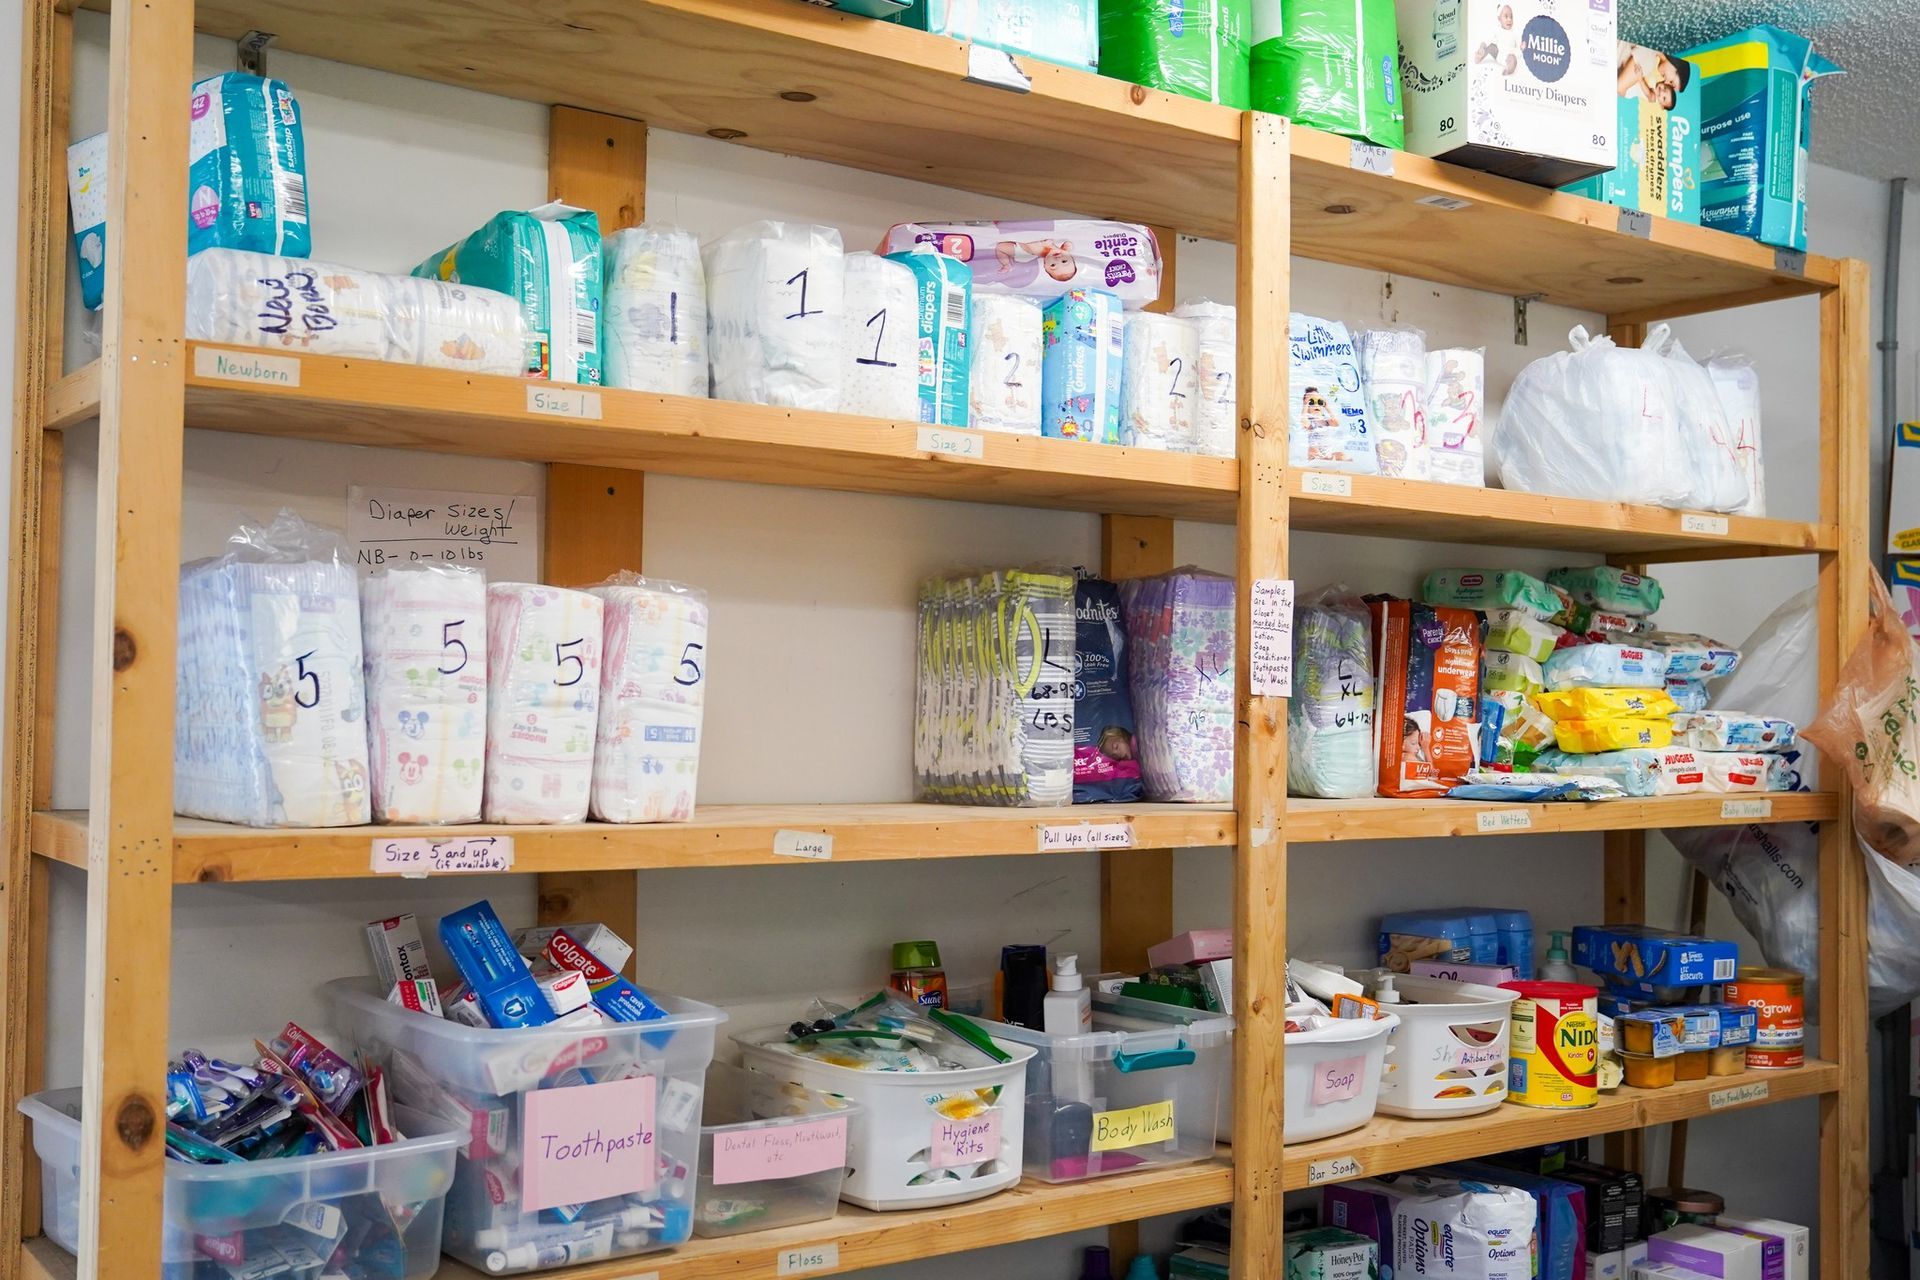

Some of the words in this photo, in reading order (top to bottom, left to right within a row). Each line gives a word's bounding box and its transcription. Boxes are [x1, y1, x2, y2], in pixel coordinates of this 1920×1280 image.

[1527, 33, 1565, 57] Millie
[1533, 52, 1561, 66] MOON
[1504, 79, 1544, 100] Luxury
[1545, 87, 1588, 107] Diapers
[192, 96, 205, 111] 42
[1439, 117, 1454, 132] 80
[1701, 119, 1733, 136] urpose
[1735, 112, 1751, 123] use
[285, 127, 296, 168] diapers
[1592, 134, 1606, 146] 80
[1353, 143, 1387, 157] WOMEN
[1656, 116, 1665, 200] swaddlers
[1363, 157, 1376, 170] M
[1670, 115, 1690, 213] Pampers
[1629, 220, 1637, 232] L
[1095, 236, 1138, 250] Gentle
[1112, 247, 1137, 257] Dry
[785, 267, 824, 320] 1
[920, 280, 937, 334] diapers
[856, 308, 898, 367] 1
[1306, 323, 1334, 345] Little
[1291, 342, 1352, 361] Swimmers
[216, 355, 289, 382] Newborn
[1003, 352, 1023, 387] 2
[1168, 357, 1186, 398] 2
[534, 393, 570, 412] Size
[1341, 407, 1364, 416] NEMO
[1358, 418, 1367, 434] 3
[1442, 390, 1476, 449] 3
[931, 432, 957, 451] Size
[963, 442, 973, 454] 2
[1737, 418, 1757, 496] 4
[1311, 477, 1333, 491] Size
[1338, 479, 1346, 493] 3
[368, 499, 436, 522] Diaper
[444, 522, 513, 544] Weight
[1687, 517, 1705, 531] Size
[1711, 519, 1718, 529] 4
[1254, 581, 1286, 598] Samples
[1075, 597, 1120, 621] odnites
[1253, 598, 1265, 606] are
[1281, 597, 1292, 607] the
[1279, 608, 1285, 617] in
[1599, 614, 1627, 628] HUGGIES
[1253, 619, 1276, 628] marked
[1278, 619, 1290, 629] bins
[1254, 631, 1275, 641] Lotion
[437, 619, 468, 675] 5
[1043, 627, 1071, 673] L
[1253, 651, 1291, 661] Conditioner
[1254, 642, 1269, 653] Soap
[1620, 649, 1644, 660] HUGGIES
[553, 638, 584, 686] 5
[673, 643, 703, 686] 5
[1084, 654, 1109, 663] 100%
[1253, 661, 1289, 675] Toothpaste
[295, 649, 320, 709] 5
[1252, 671, 1267, 687] Body
[1270, 675, 1288, 686] Wash
[1338, 659, 1352, 680] L
[1437, 666, 1476, 678] underwear
[1341, 681, 1363, 701] XL
[1032, 708, 1072, 733] LBS
[1665, 753, 1695, 765] HUGGIES
[1043, 829, 1060, 844] Pull
[1065, 831, 1082, 845] Ups
[1086, 828, 1102, 844] (all
[1104, 829, 1130, 844] sizes)
[384, 843, 421, 863] Size
[430, 845, 441, 859] 5
[445, 847, 467, 859] and
[473, 849, 489, 862] up
[795, 840, 823, 857] Large
[1746, 823, 1805, 890] rshalls.com
[456, 857, 508, 870] available)
[396, 944, 414, 981] ontax
[552, 935, 597, 976] Colgate
[919, 992, 942, 1006] Suave
[1763, 1005, 1793, 1018] grow
[1325, 1070, 1355, 1091] Soap
[1098, 1115, 1138, 1142] Body
[1142, 1103, 1173, 1134] Wash
[540, 1122, 653, 1163] Toothpaste
[942, 1121, 990, 1145] Hygiene
[725, 1137, 756, 1152] Dental
[1310, 1165, 1325, 1181] Bar
[1332, 1160, 1356, 1178] Soap
[1487, 1228, 1512, 1237] equate
[1413, 1217, 1429, 1275] Options
[1443, 1223, 1455, 1272] equate
[1488, 1248, 1517, 1260] Options
[788, 1252, 823, 1268] Floss
[1331, 1254, 1352, 1267] Honey
